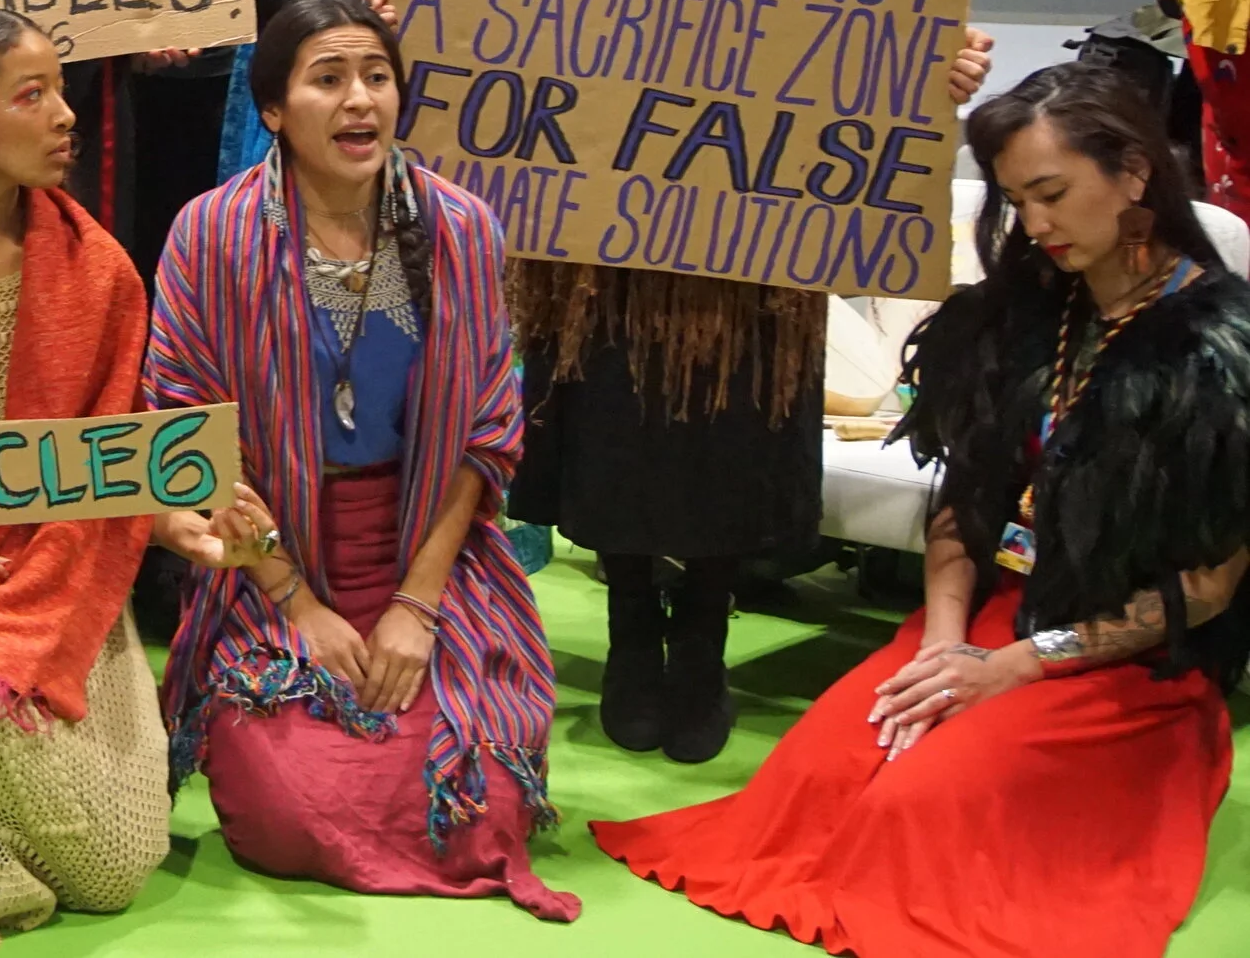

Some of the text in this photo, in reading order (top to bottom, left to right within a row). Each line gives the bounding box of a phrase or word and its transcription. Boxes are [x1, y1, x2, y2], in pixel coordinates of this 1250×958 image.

[395, 60, 945, 214] FOR FALSE
[775, 3, 959, 125] ZONE
[400, 147, 934, 294] MATE SOLUTIONS
